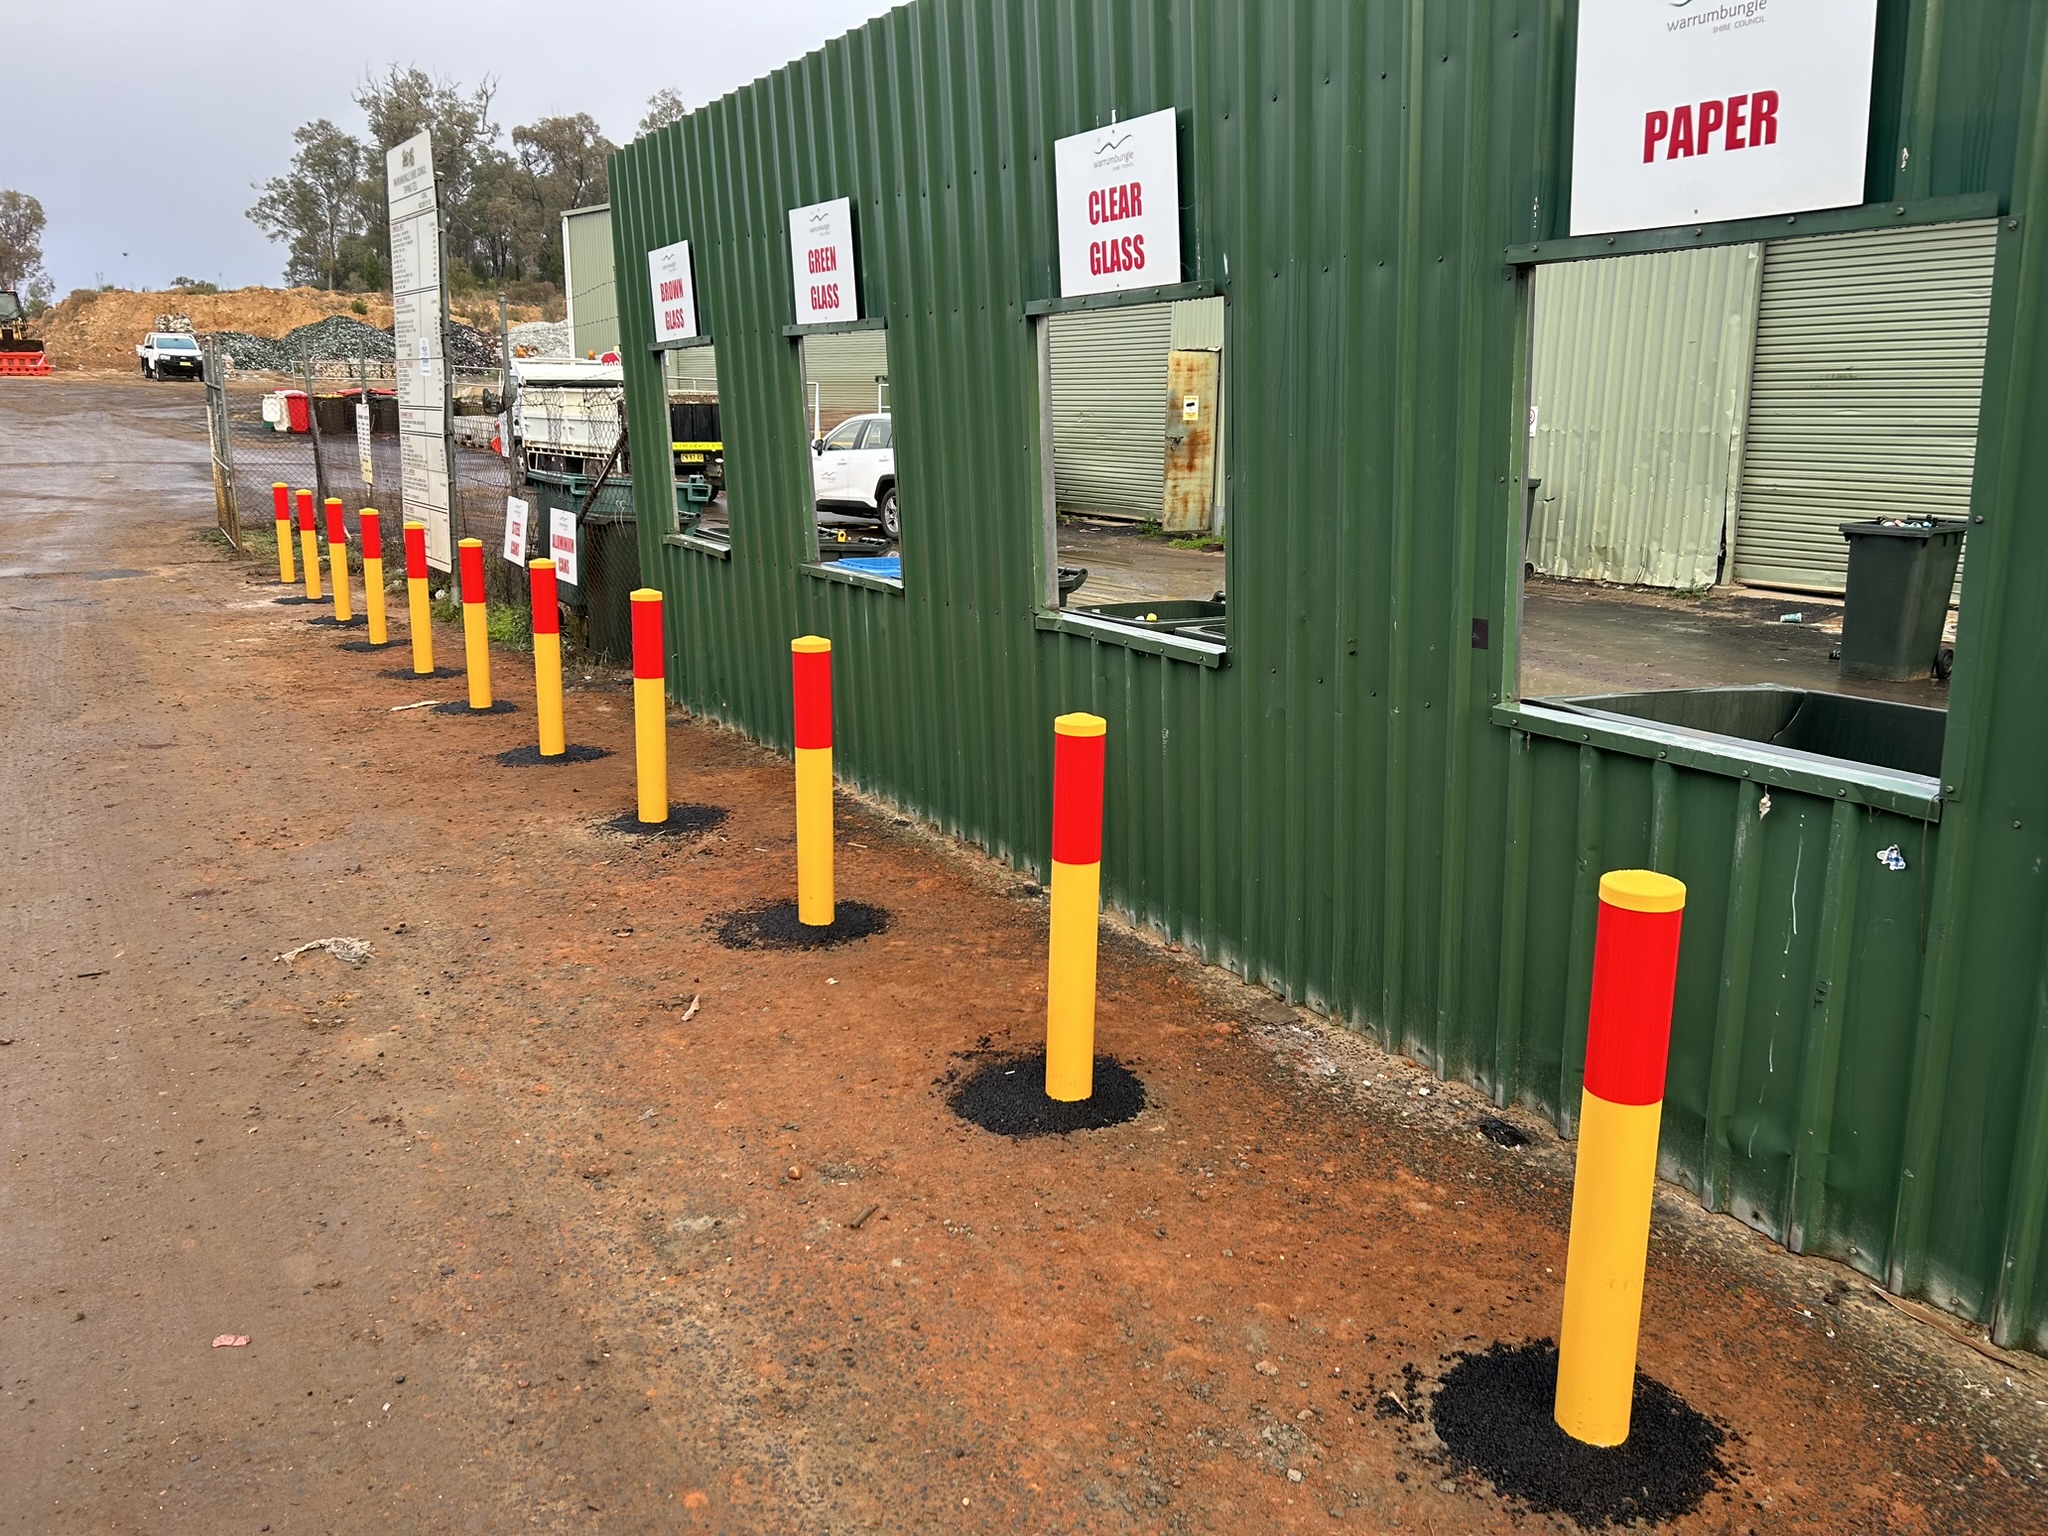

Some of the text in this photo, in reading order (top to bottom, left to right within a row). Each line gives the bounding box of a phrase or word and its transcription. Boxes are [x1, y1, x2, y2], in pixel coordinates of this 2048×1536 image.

[1667, 0, 1767, 32] warrumbungle
[1712, 16, 1765, 34] SHIRE COUNCIL
[1642, 90, 1779, 164] PAPER
[1089, 182, 1143, 226] CLEAR
[808, 246, 837, 275] GREEN
[1089, 234, 1145, 276] GLASS
[660, 278, 684, 302] BROWN
[810, 283, 840, 311] GLASS
[665, 308, 685, 331] GLASS
